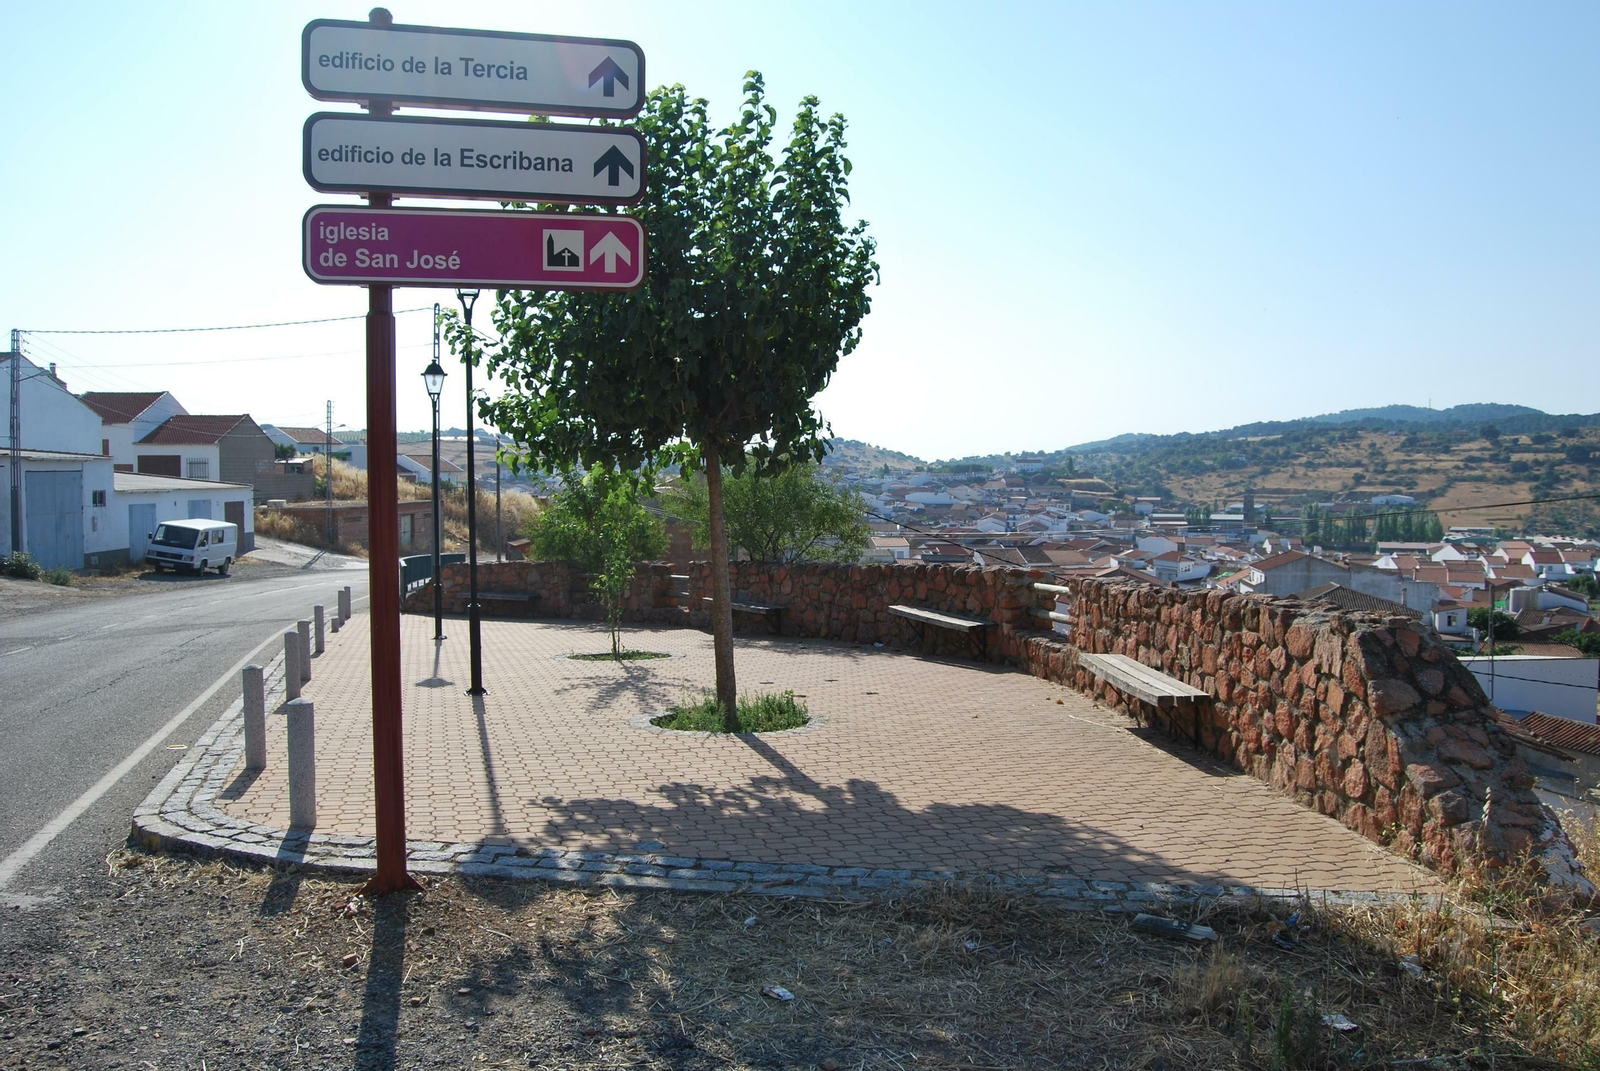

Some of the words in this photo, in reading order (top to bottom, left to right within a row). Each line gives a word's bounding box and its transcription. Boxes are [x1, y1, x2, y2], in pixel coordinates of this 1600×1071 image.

[318, 51, 395, 72] edificio
[401, 54, 426, 74] de
[434, 56, 452, 76] la
[459, 57, 528, 81] Tercia
[317, 145, 394, 164] edificio
[401, 147, 426, 166] de
[434, 147, 452, 167] la
[459, 148, 574, 173] Escribana
[319, 222, 389, 245] iglesia
[319, 248, 348, 267] de
[354, 248, 399, 268] San
[405, 249, 461, 270] José
